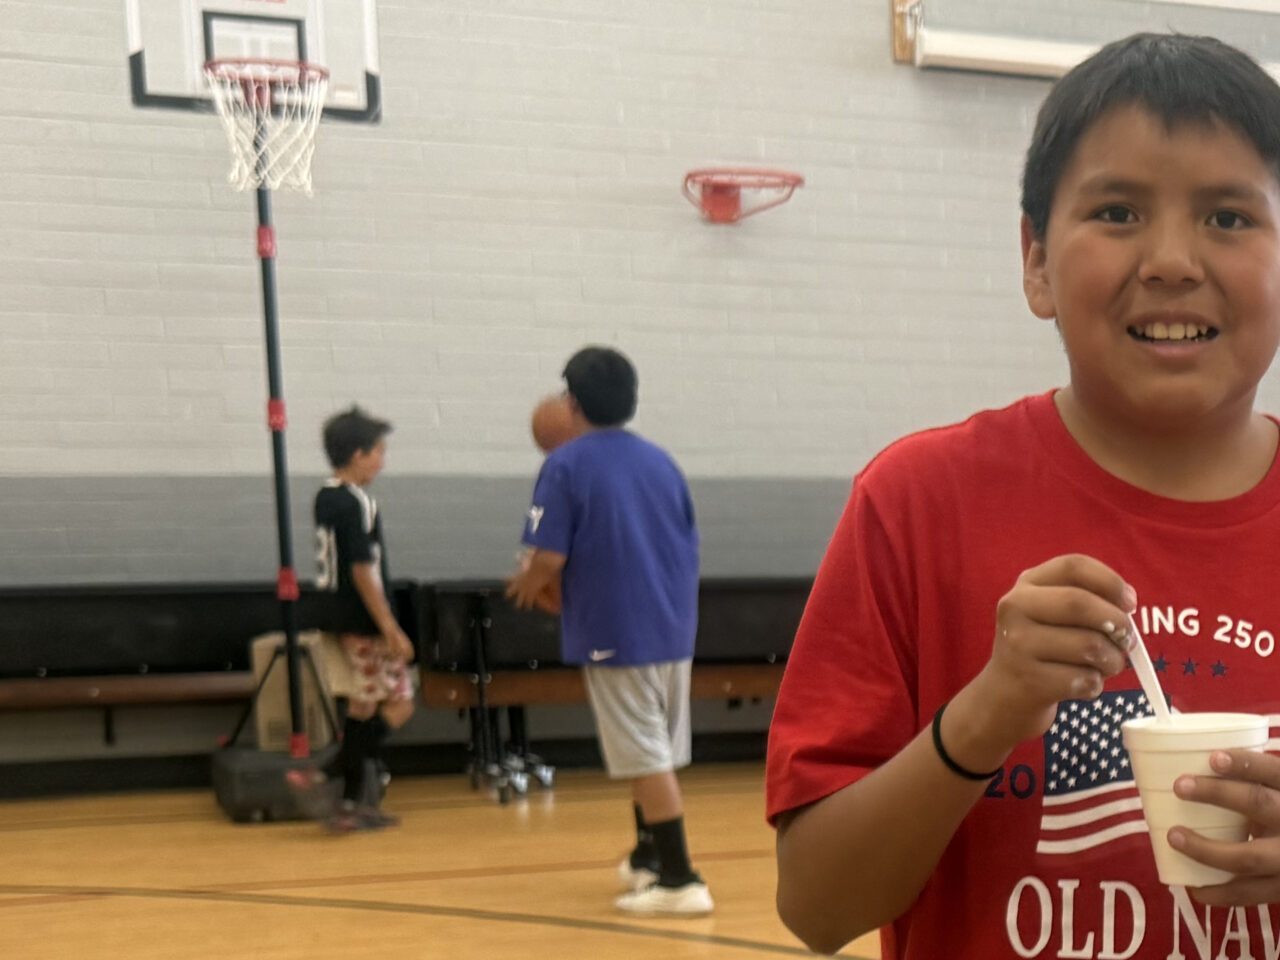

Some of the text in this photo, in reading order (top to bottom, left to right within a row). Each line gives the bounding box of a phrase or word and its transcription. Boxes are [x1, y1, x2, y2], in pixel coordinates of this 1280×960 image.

[1141, 605, 1200, 637] ING
[1213, 614, 1275, 657] 250
[1006, 875, 1146, 960] OLD
